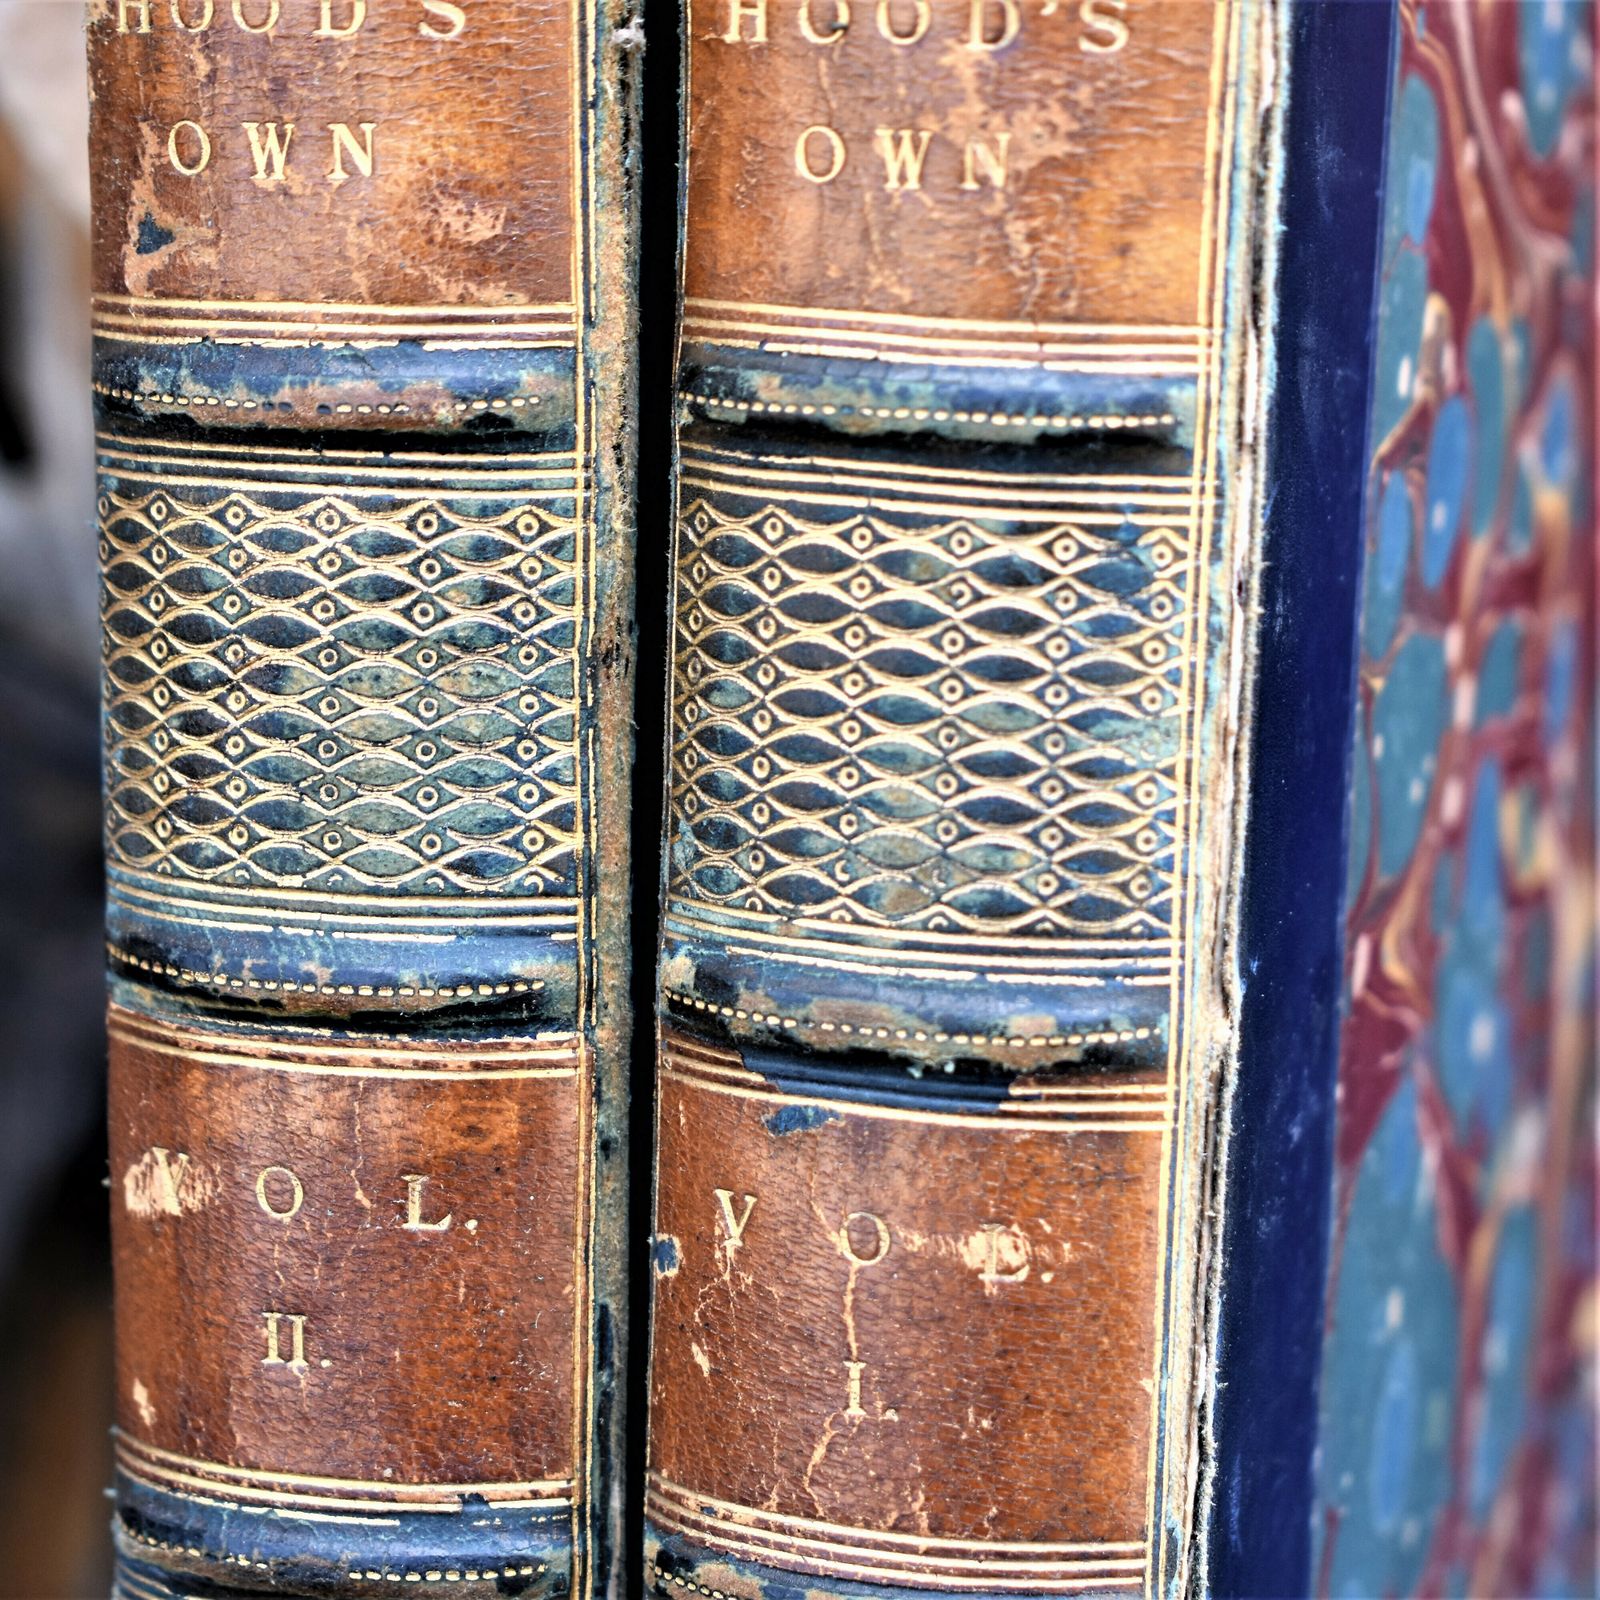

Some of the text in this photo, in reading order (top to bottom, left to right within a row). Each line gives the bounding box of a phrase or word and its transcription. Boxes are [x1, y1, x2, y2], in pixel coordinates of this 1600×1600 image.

[166, 119, 378, 181] OWN
[794, 125, 1012, 191] OWN
[150, 1146, 479, 1236] VOL.
[713, 1188, 1055, 1284] VOL.
[261, 1311, 333, 1369] II.
[844, 1361, 900, 1422] I.
